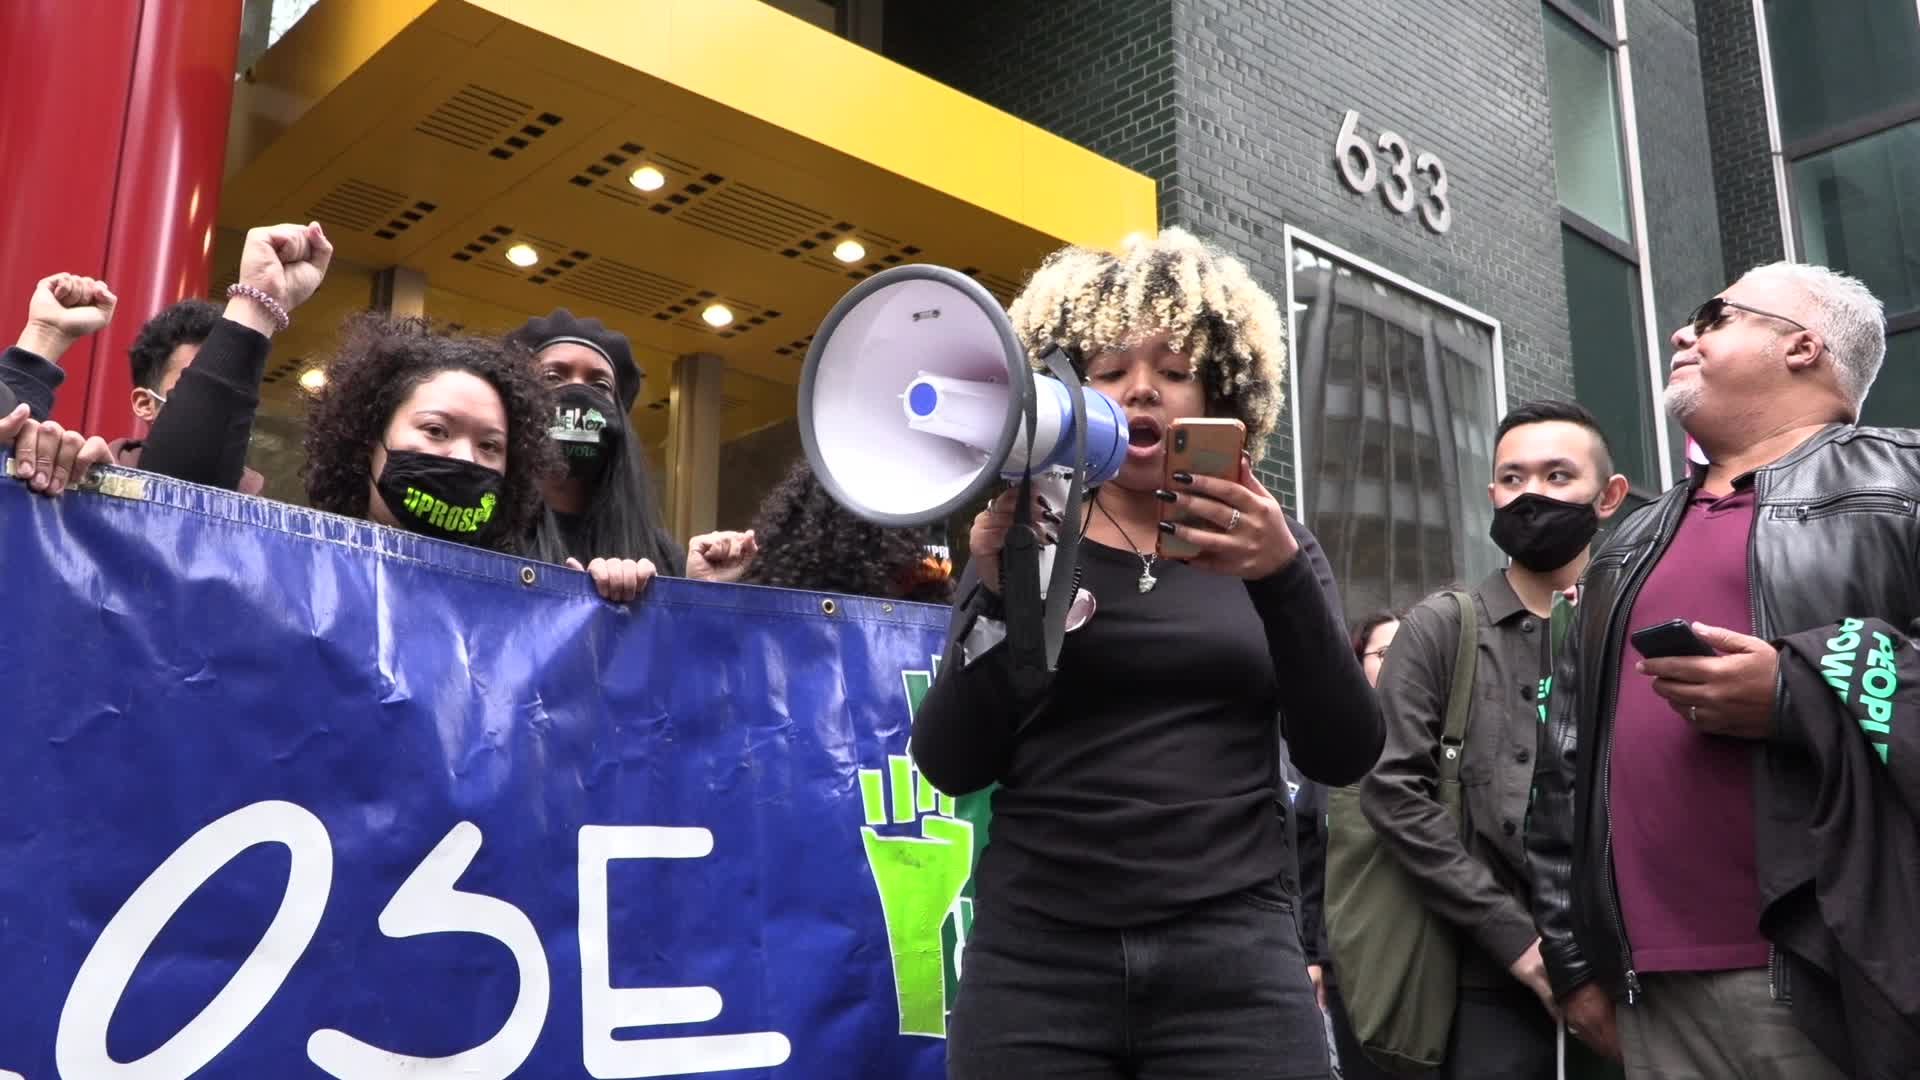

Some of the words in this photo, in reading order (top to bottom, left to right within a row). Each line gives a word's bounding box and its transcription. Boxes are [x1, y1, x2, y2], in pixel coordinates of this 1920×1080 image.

[1335, 109, 1451, 233] 633
[403, 486, 485, 532] UPROSE
[1820, 617, 1864, 704] POW
[0, 800, 791, 1080] OSE
